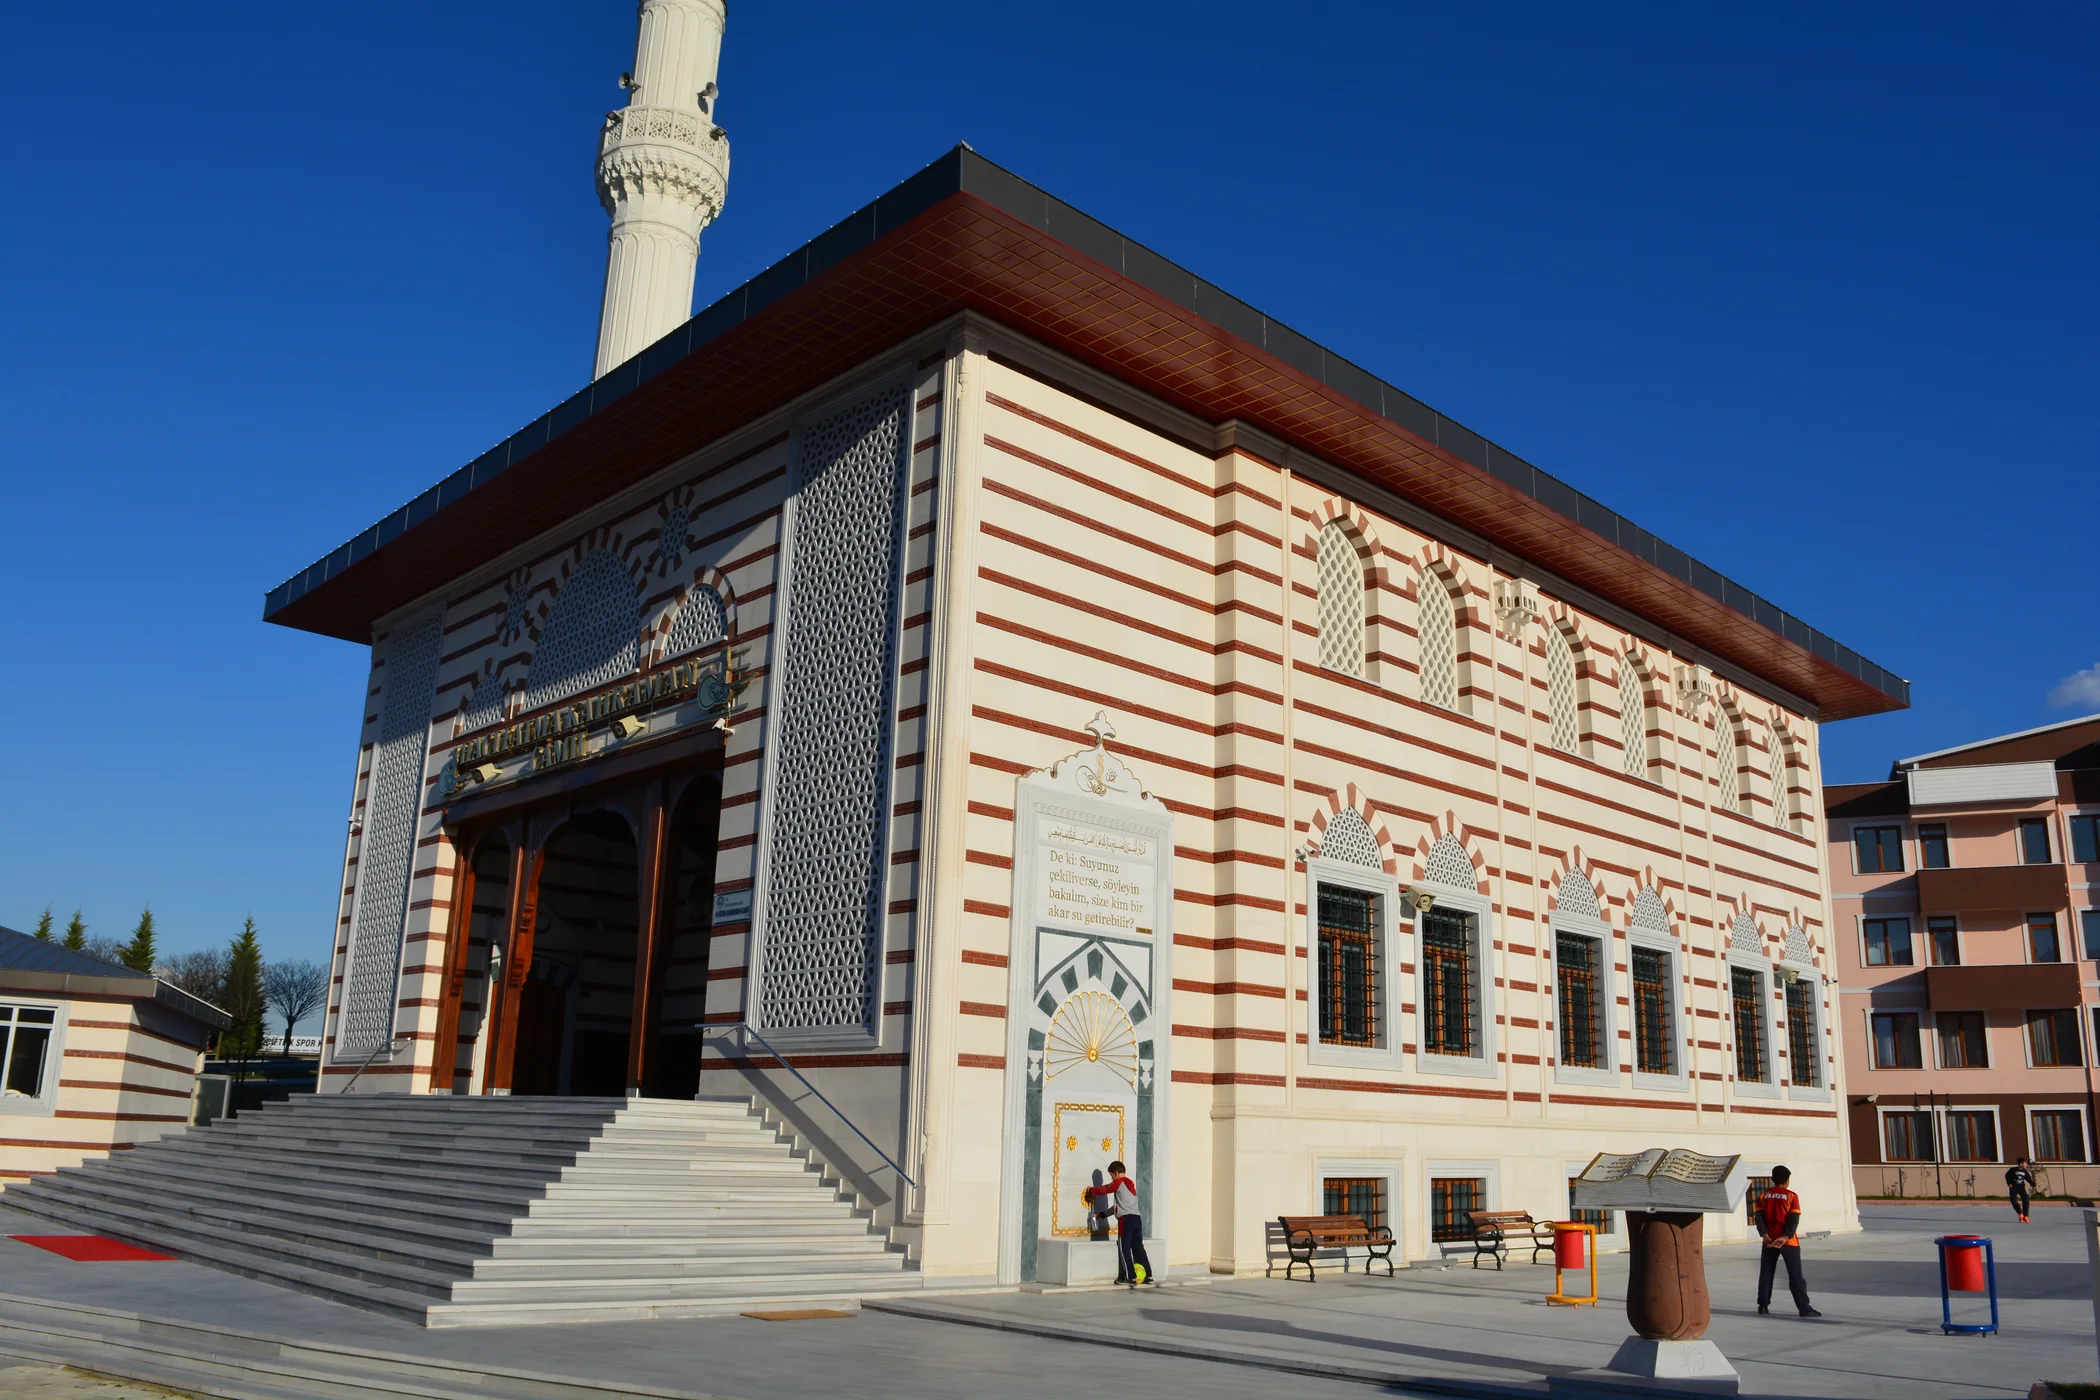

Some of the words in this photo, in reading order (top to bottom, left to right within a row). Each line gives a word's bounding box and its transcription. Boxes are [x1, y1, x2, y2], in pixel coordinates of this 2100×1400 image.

[568, 657, 700, 729] KAHRAMAN
[1050, 850, 1064, 863] De
[1066, 852, 1077, 866] ki:
[1080, 855, 1120, 874] Suyunuz
[1049, 869, 1101, 890] çekiliverse,
[1103, 878, 1140, 896] söyleyin
[1049, 886, 1090, 906] bakalım,
[1091, 894, 1109, 908] size
[1111, 896, 1129, 911] kim
[1130, 900, 1144, 913] bir
[1048, 905, 1070, 919] akar
[1071, 911, 1083, 921] su
[1084, 912, 1135, 929] getirebilir?
[296, 1039, 316, 1047] SPOR
